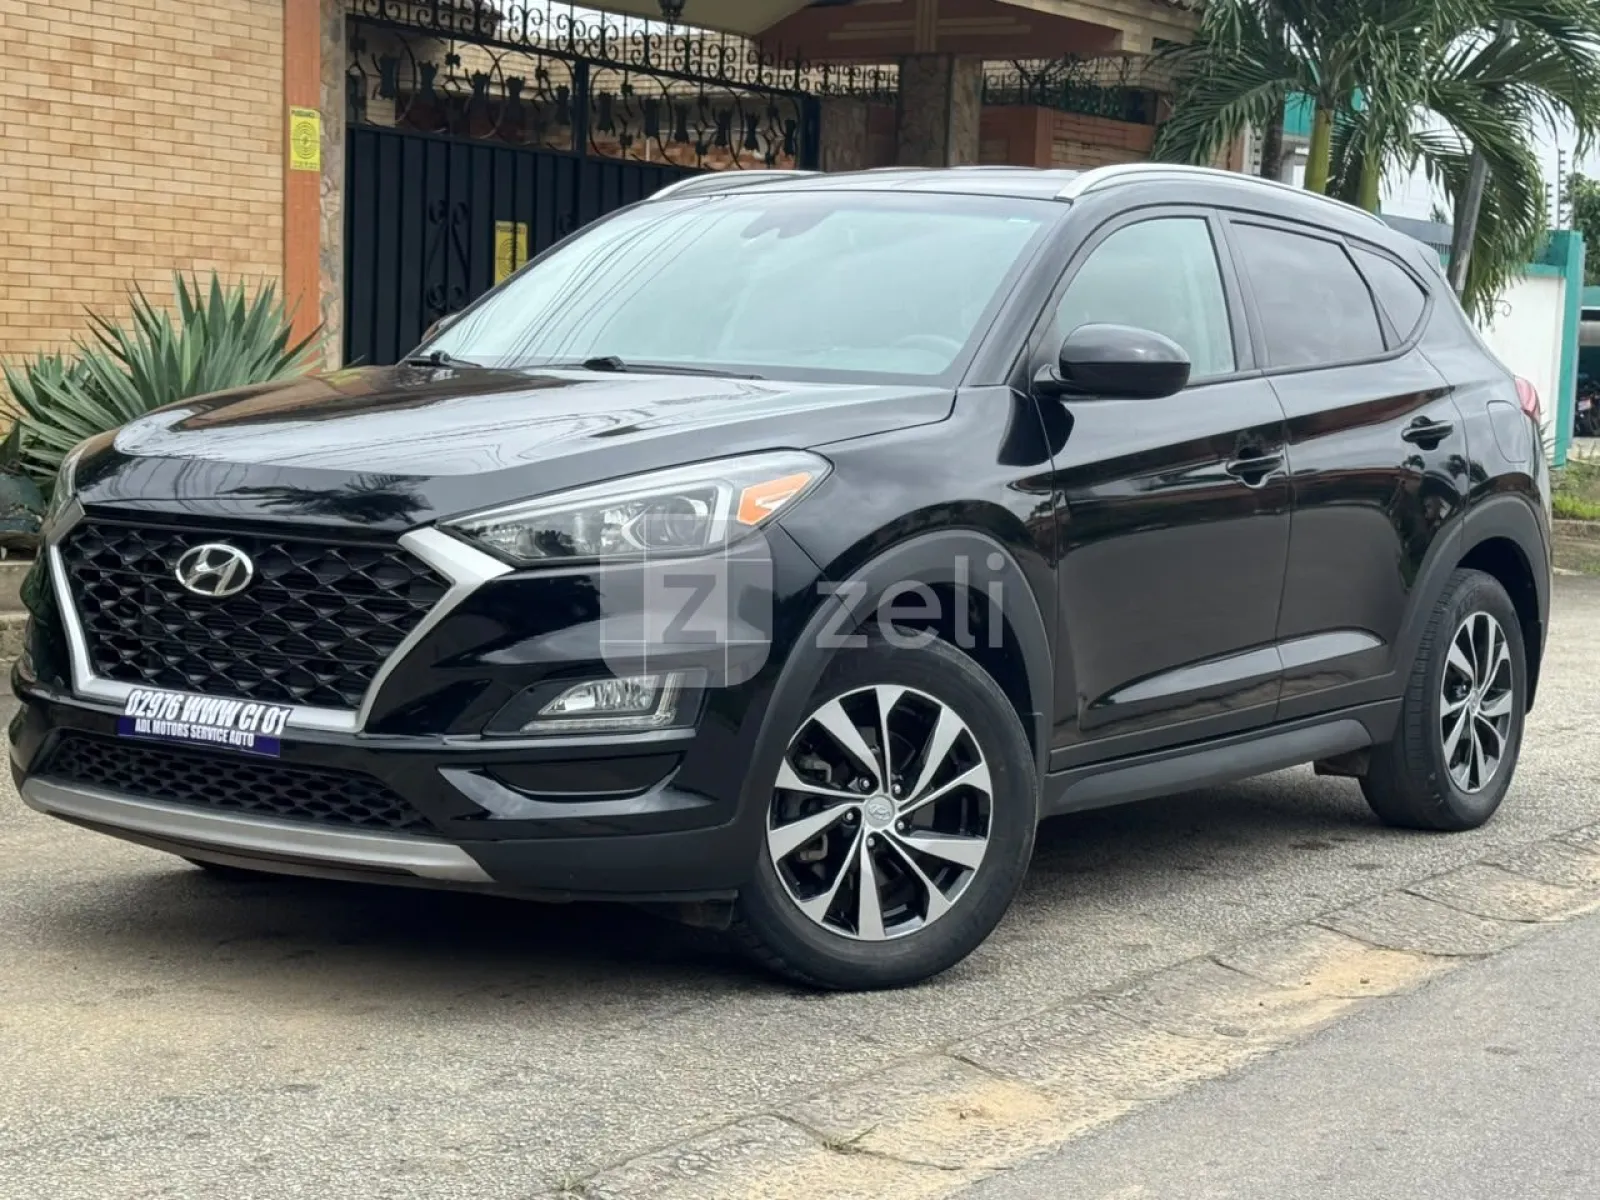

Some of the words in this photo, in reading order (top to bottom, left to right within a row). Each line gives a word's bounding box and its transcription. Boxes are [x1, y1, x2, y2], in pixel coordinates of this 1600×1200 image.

[124, 689, 185, 718] 02976
[238, 703, 266, 731] CI
[261, 706, 291, 736] 01
[152, 720, 190, 738] MOTORS
[190, 724, 228, 743] SERVICE
[229, 730, 255, 747] AUTO
